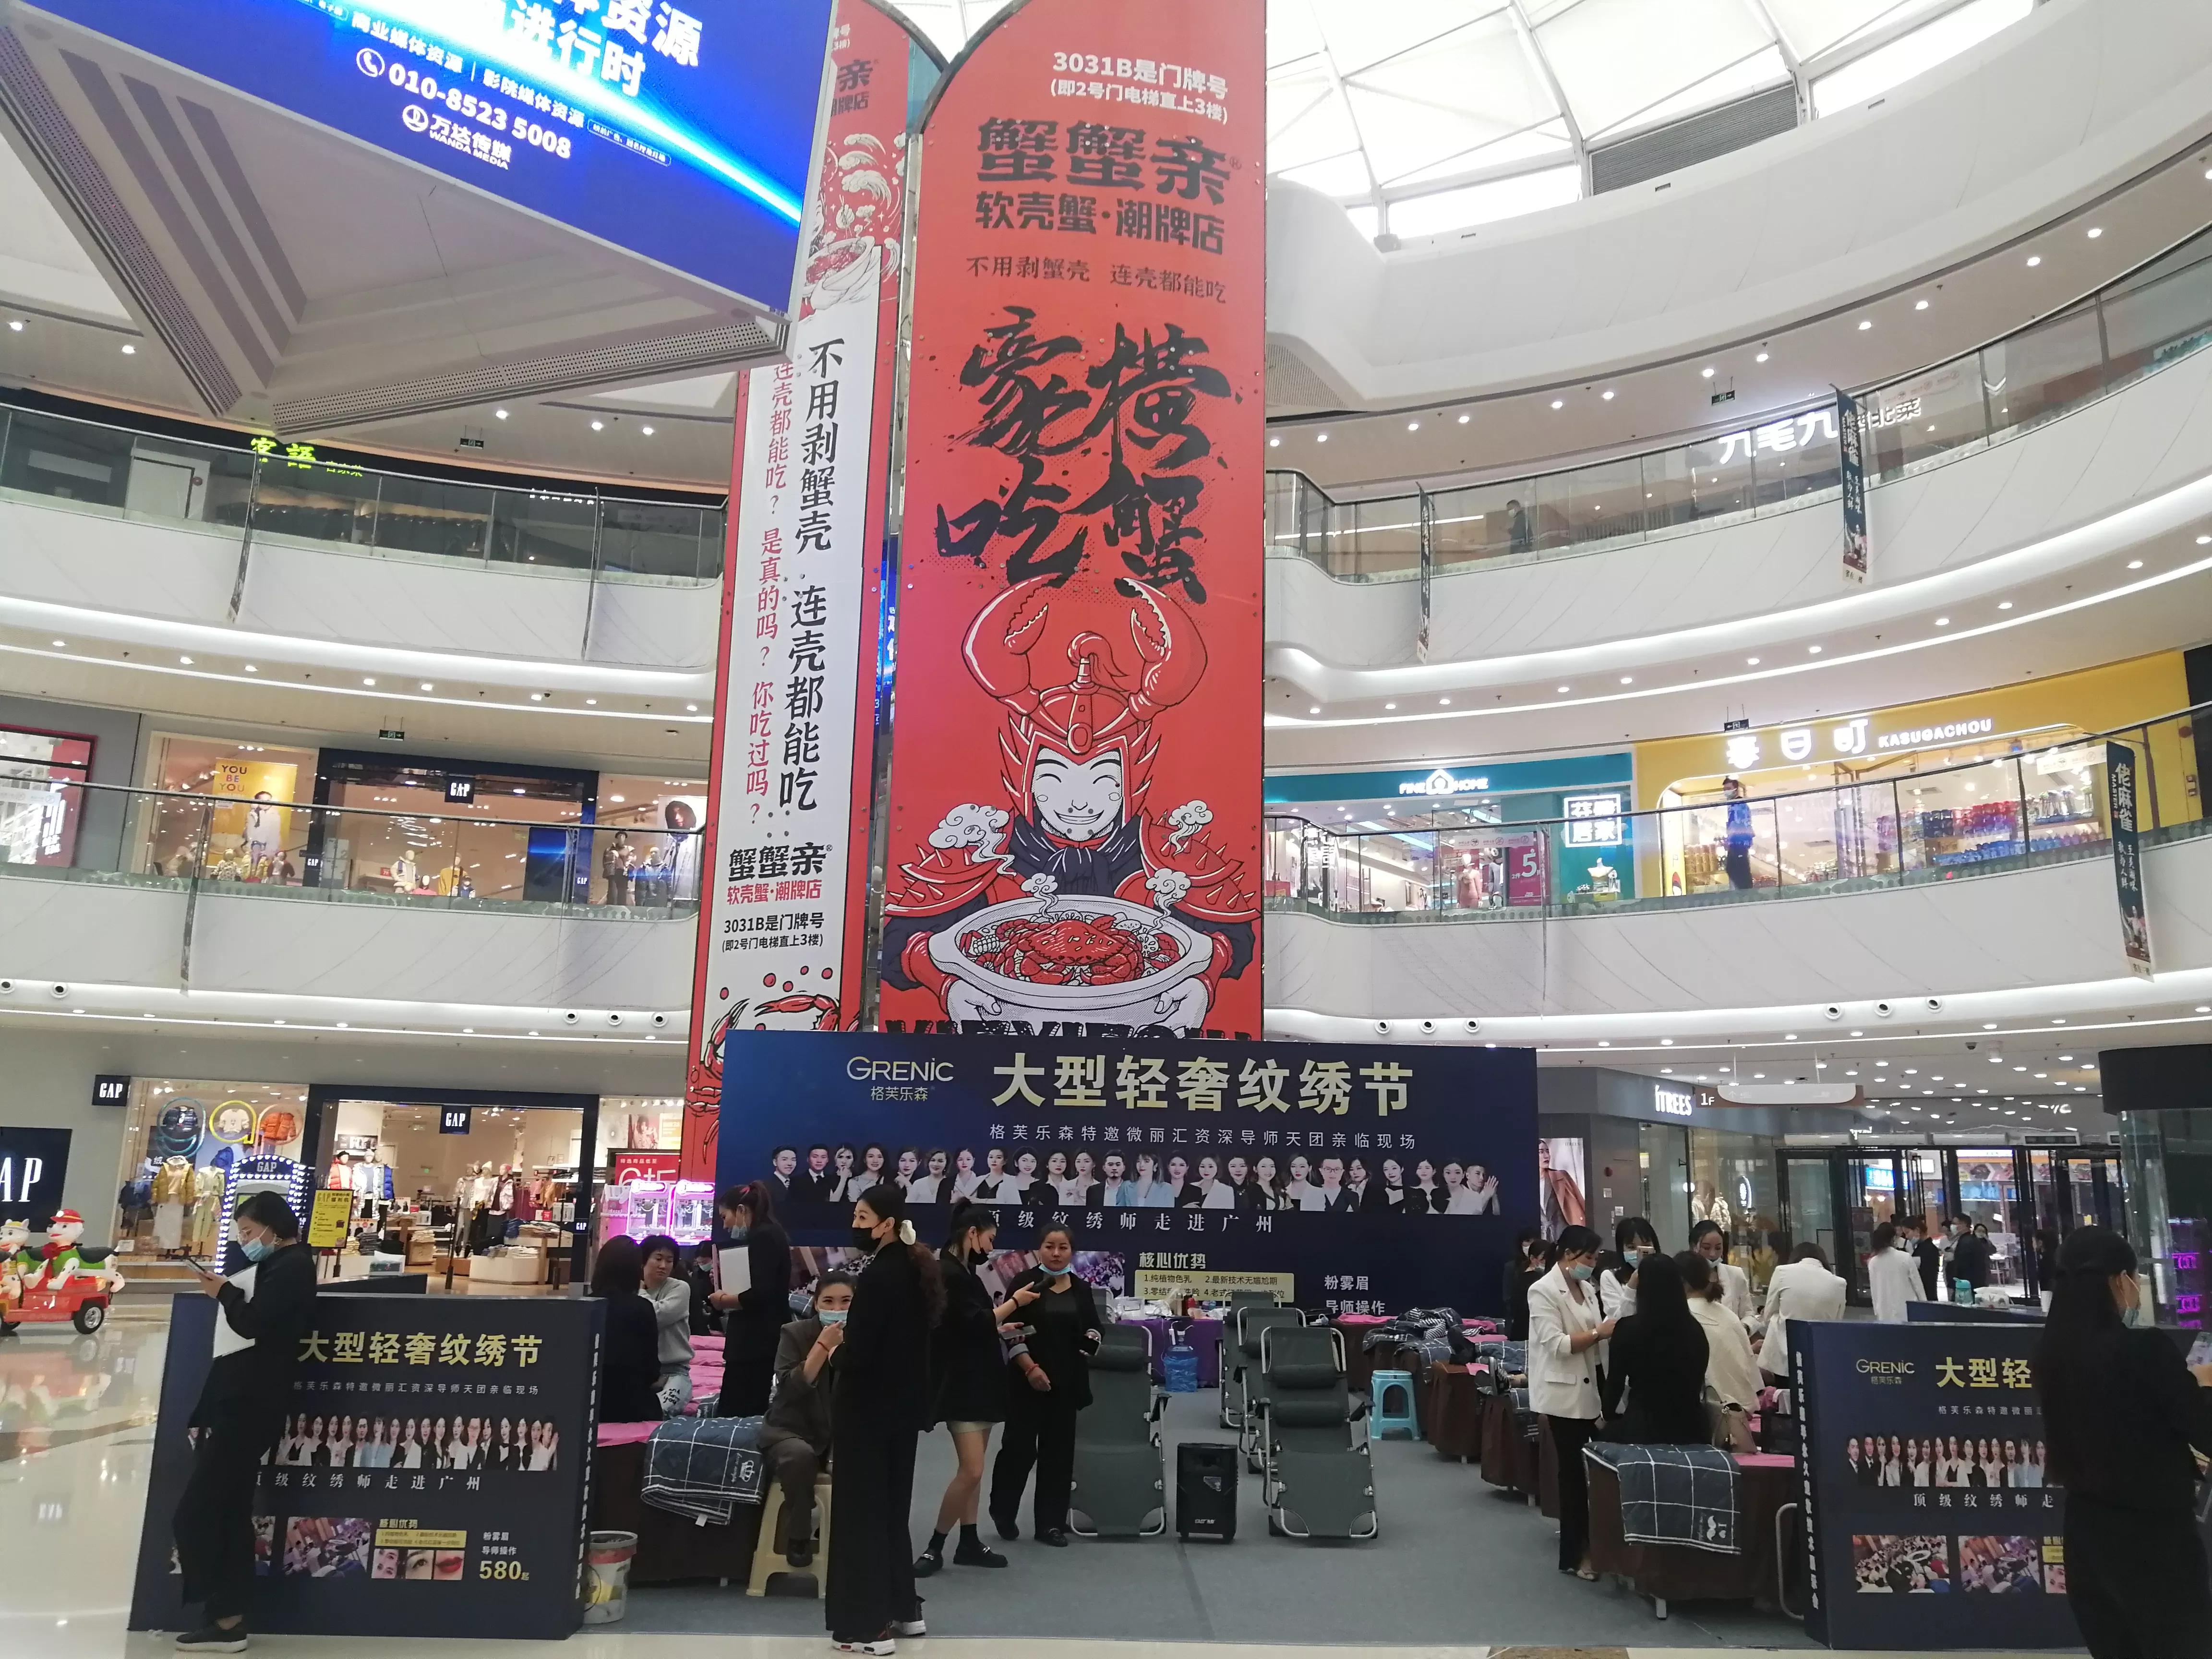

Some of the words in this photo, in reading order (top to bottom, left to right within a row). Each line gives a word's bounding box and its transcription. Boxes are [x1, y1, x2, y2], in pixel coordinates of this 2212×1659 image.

[351, 10, 463, 73] 商业媒体资源
[483, 68, 585, 128] 影院媒体资源
[1053, 51, 1228, 99] 3031B是门牌号
[388, 63, 507, 131] 010-8523
[512, 117, 572, 159] 5008
[1051, 78, 1228, 125] (即2号门电梯直上3楼)
[429, 130, 471, 155] WANDA
[472, 148, 509, 170] MEDIA
[431, 114, 512, 162] 万达传媒
[976, 116, 1231, 206] 蟹蟹亲
[966, 256, 1090, 282] 不用剥蟹壳
[1110, 264, 1226, 304] 连壳都能吃
[795, 338, 845, 555] 不用剥蟹壳
[1719, 411, 1838, 465] 九毛九
[780, 585, 827, 811] 连壳都能吃
[1878, 718, 1992, 749] KASUGACHOU
[221, 765, 247, 774] YOU
[219, 783, 245, 792] YOU
[450, 781, 470, 798] GAP
[1399, 782, 1426, 794] FINE
[1453, 778, 1489, 791] HOME
[308, 858, 319, 867] GAP
[728, 842, 827, 883] 蟹蟹亲
[577, 877, 588, 885] GAP
[723, 911, 825, 935] 3031B是门牌号
[721, 933, 824, 953] (即2号门电梯直上3楼)
[99, 1082, 123, 1098] GAP
[870, 1085, 929, 1102] 格芙乐森
[991, 1052, 1413, 1117] 大型轻奢纹绣节
[1701, 1093, 1715, 1106] 1F
[445, 1111, 466, 1127] GAP
[989, 1124, 1416, 1150] 格芙乐森特邀微丽汇资深导师天团亲临现场
[256, 1161, 278, 1173] GAP
[576, 1222, 587, 1230] GAP
[1139, 1252, 1206, 1269] 核心优势
[1324, 1274, 1369, 1291] 粉雾眉
[1326, 1299, 1386, 1315] 导师操作
[297, 1329, 543, 1368] 大型轻奢纹绣节
[1936, 1357, 2032, 1389] 大型轻
